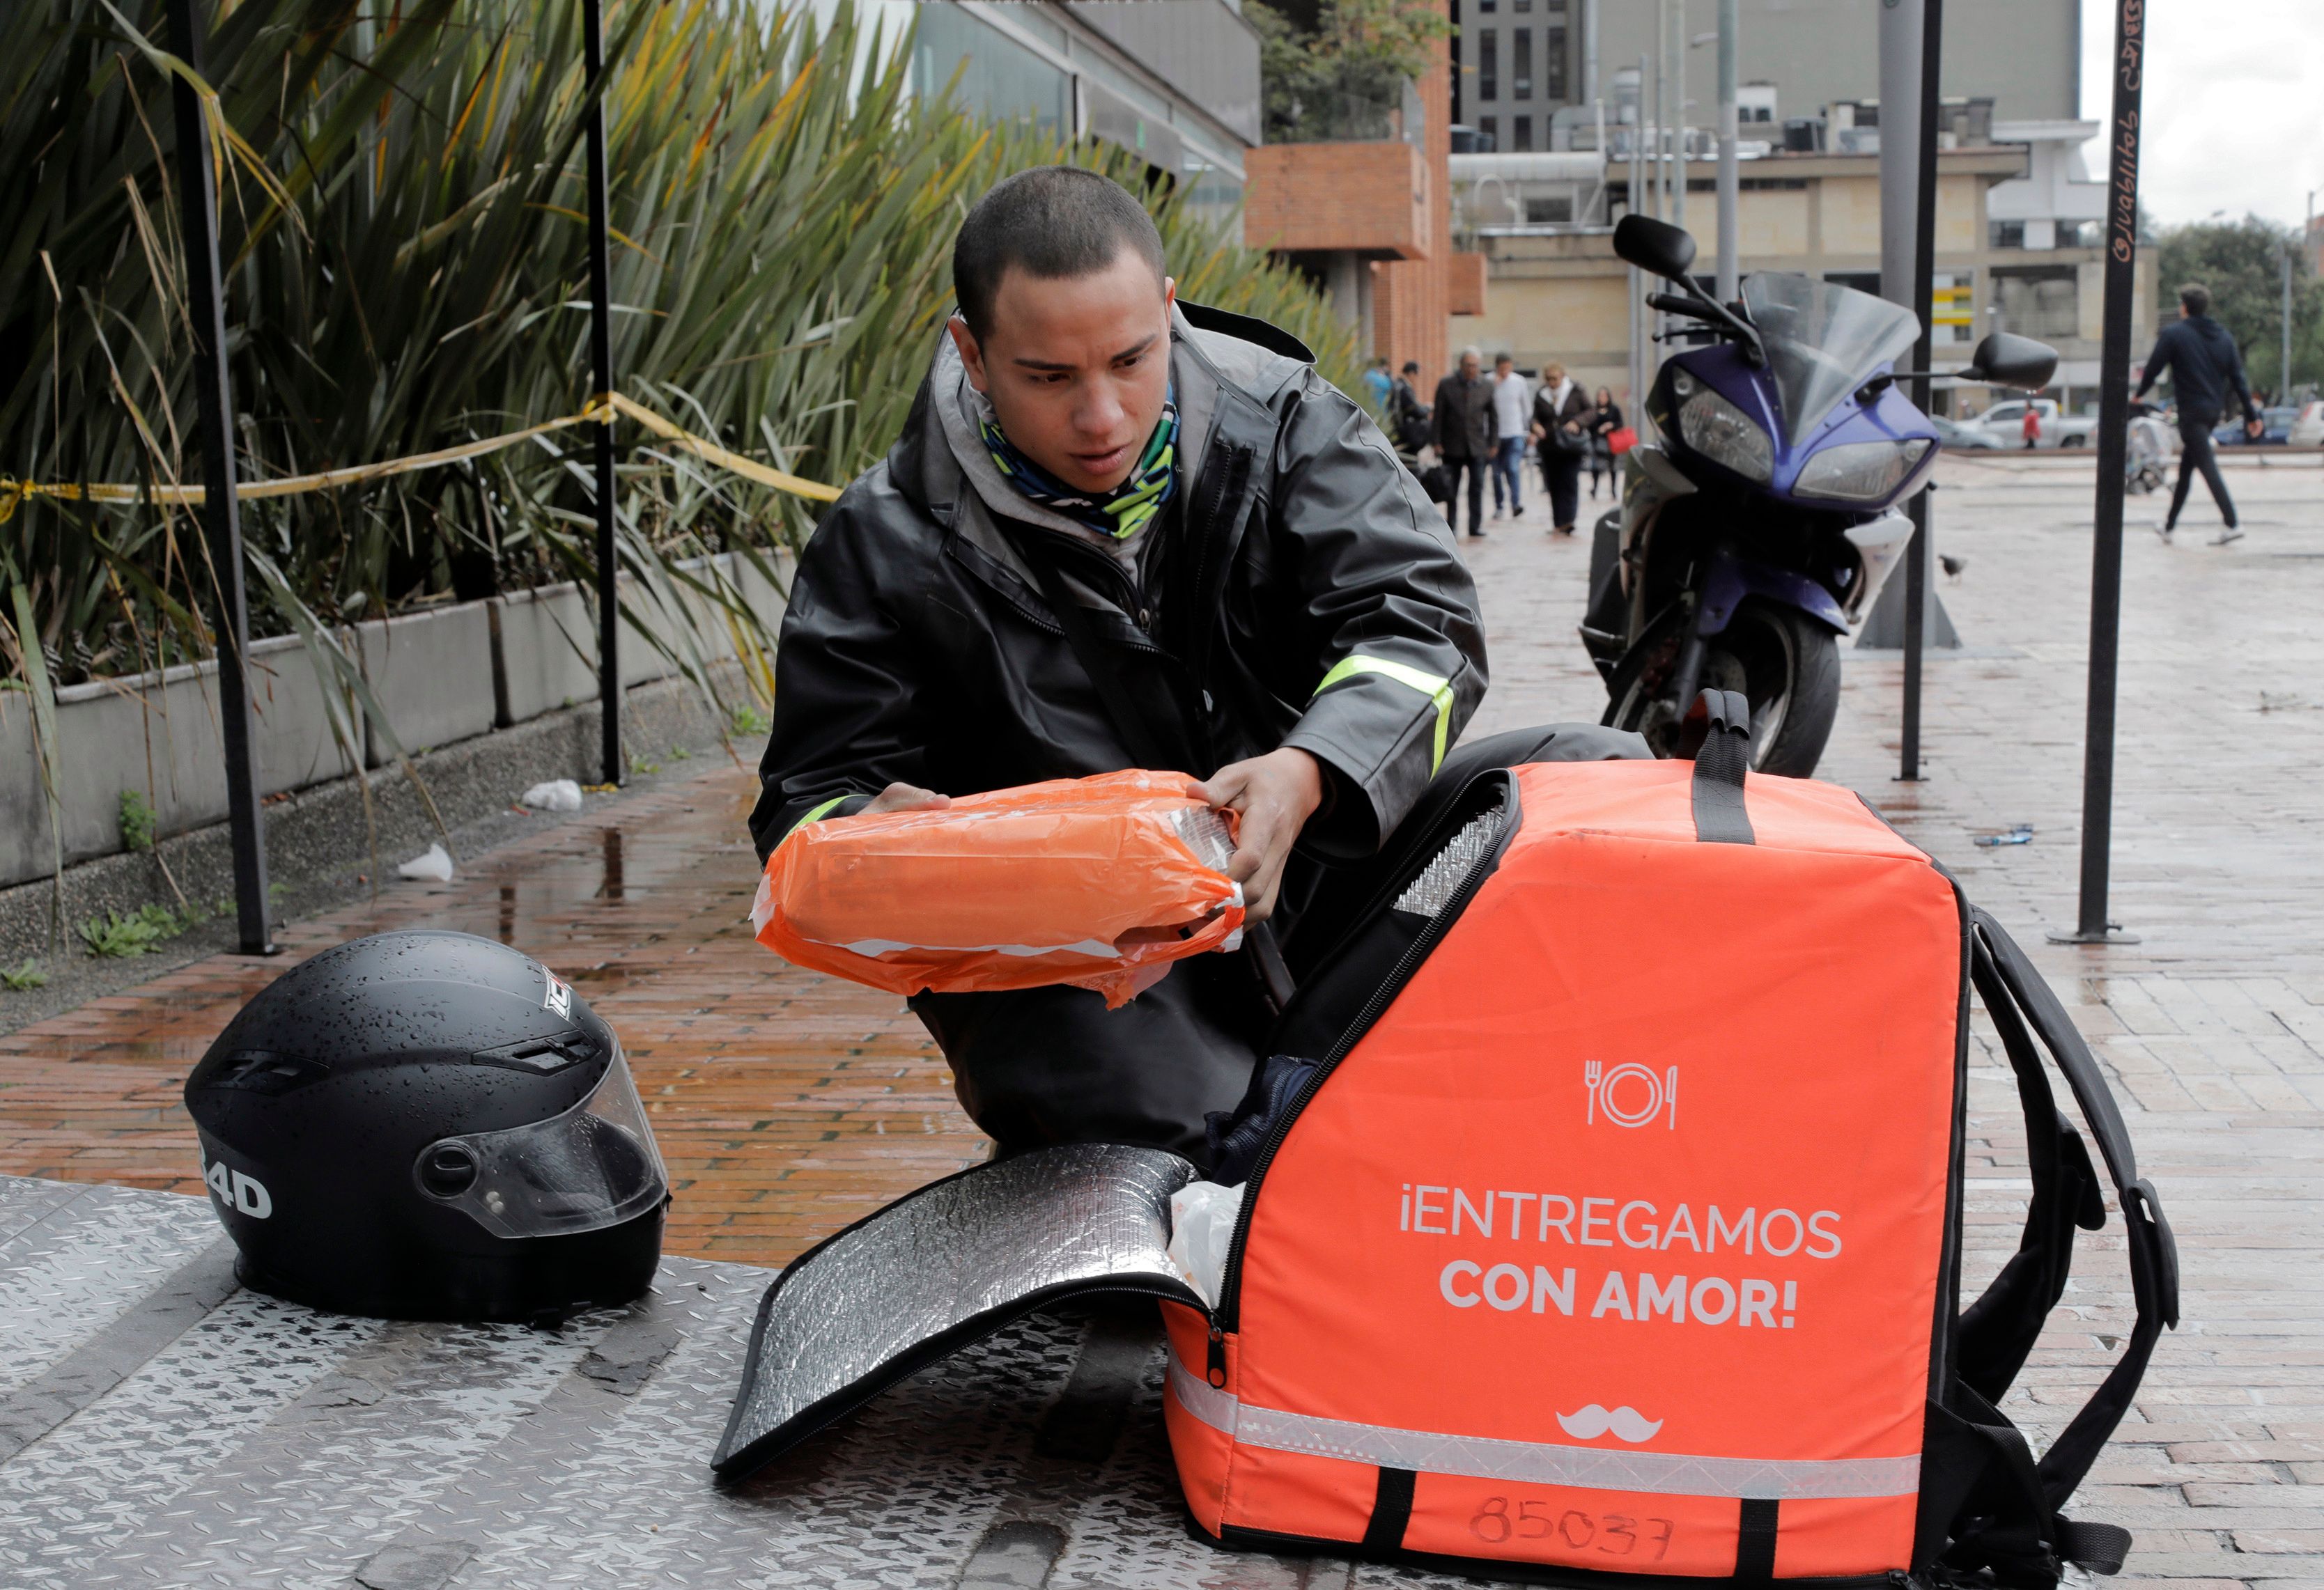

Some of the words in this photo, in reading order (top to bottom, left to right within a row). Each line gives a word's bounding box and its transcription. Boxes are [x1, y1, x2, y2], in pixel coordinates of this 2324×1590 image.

[198, 1137, 272, 1219] 4D
[1439, 1259, 1576, 1316] CON
[1590, 1270, 1797, 1328] AMOR!
[1469, 1496, 1675, 1561] 85037
